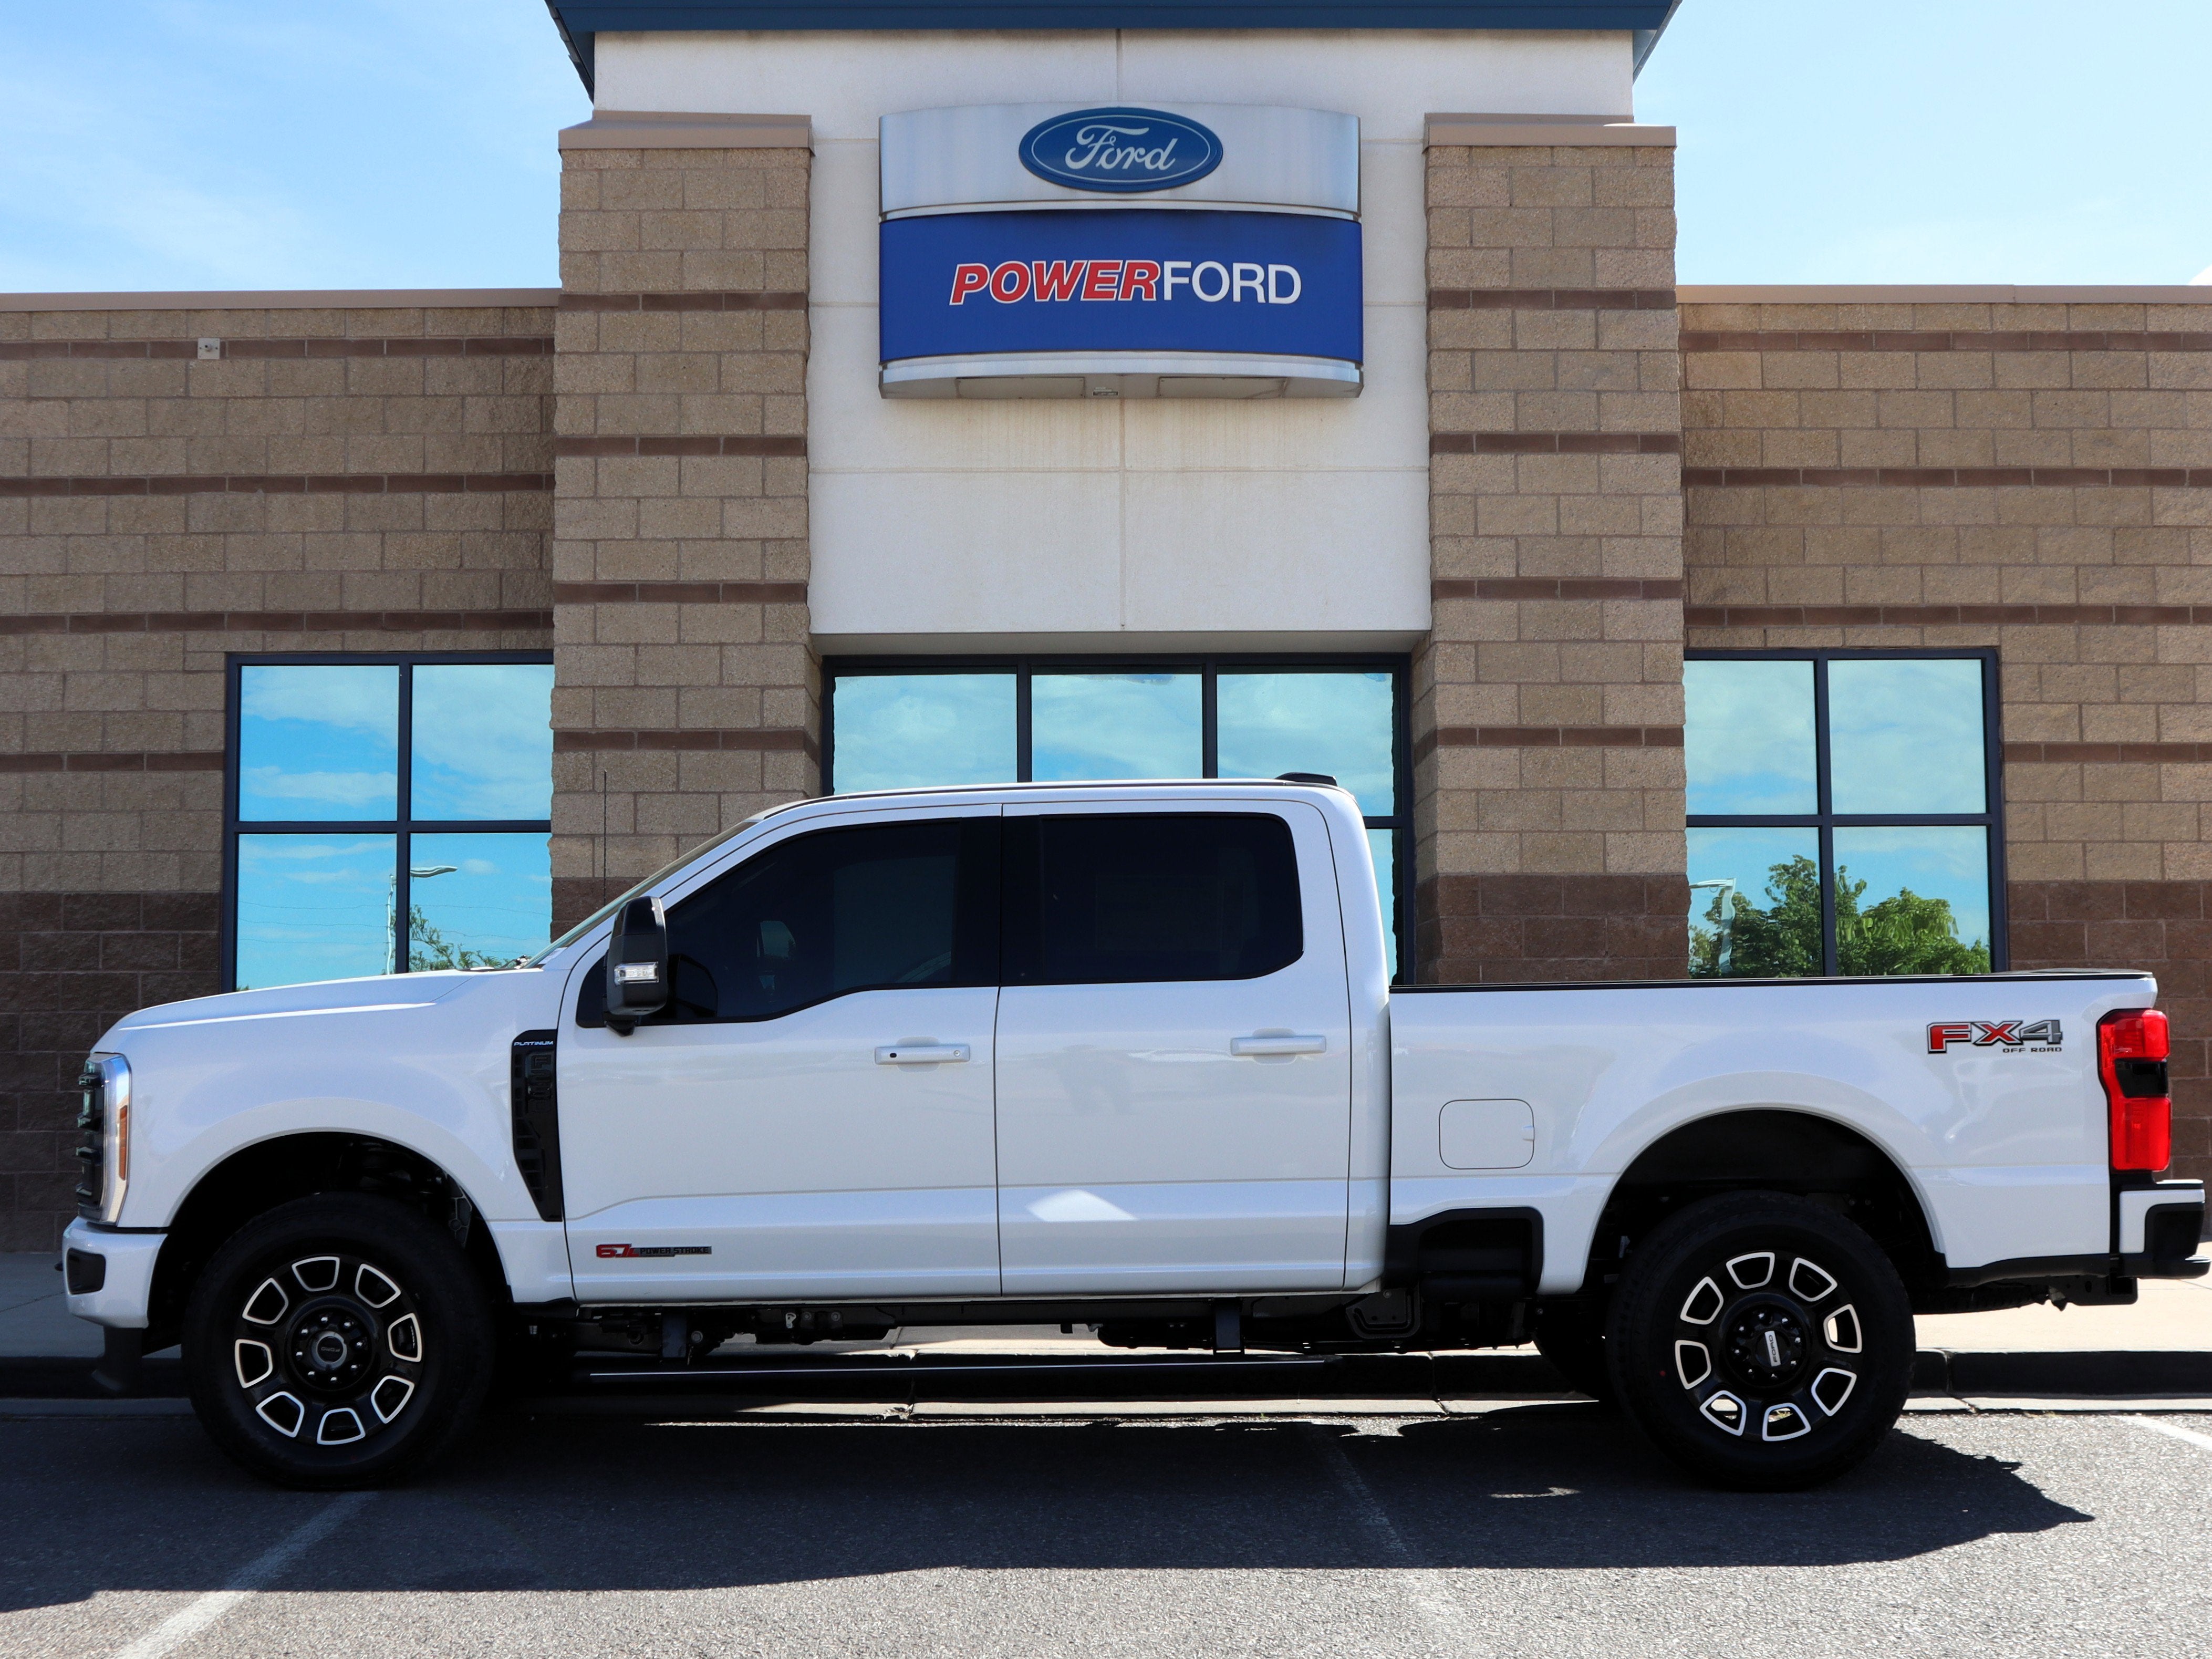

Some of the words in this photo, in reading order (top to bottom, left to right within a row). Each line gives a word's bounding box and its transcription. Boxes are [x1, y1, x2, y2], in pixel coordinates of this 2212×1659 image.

[1065, 125, 1178, 171] Ford
[1927, 1019, 2063, 1054] FX4
[1769, 1335, 1778, 1362] FORD
